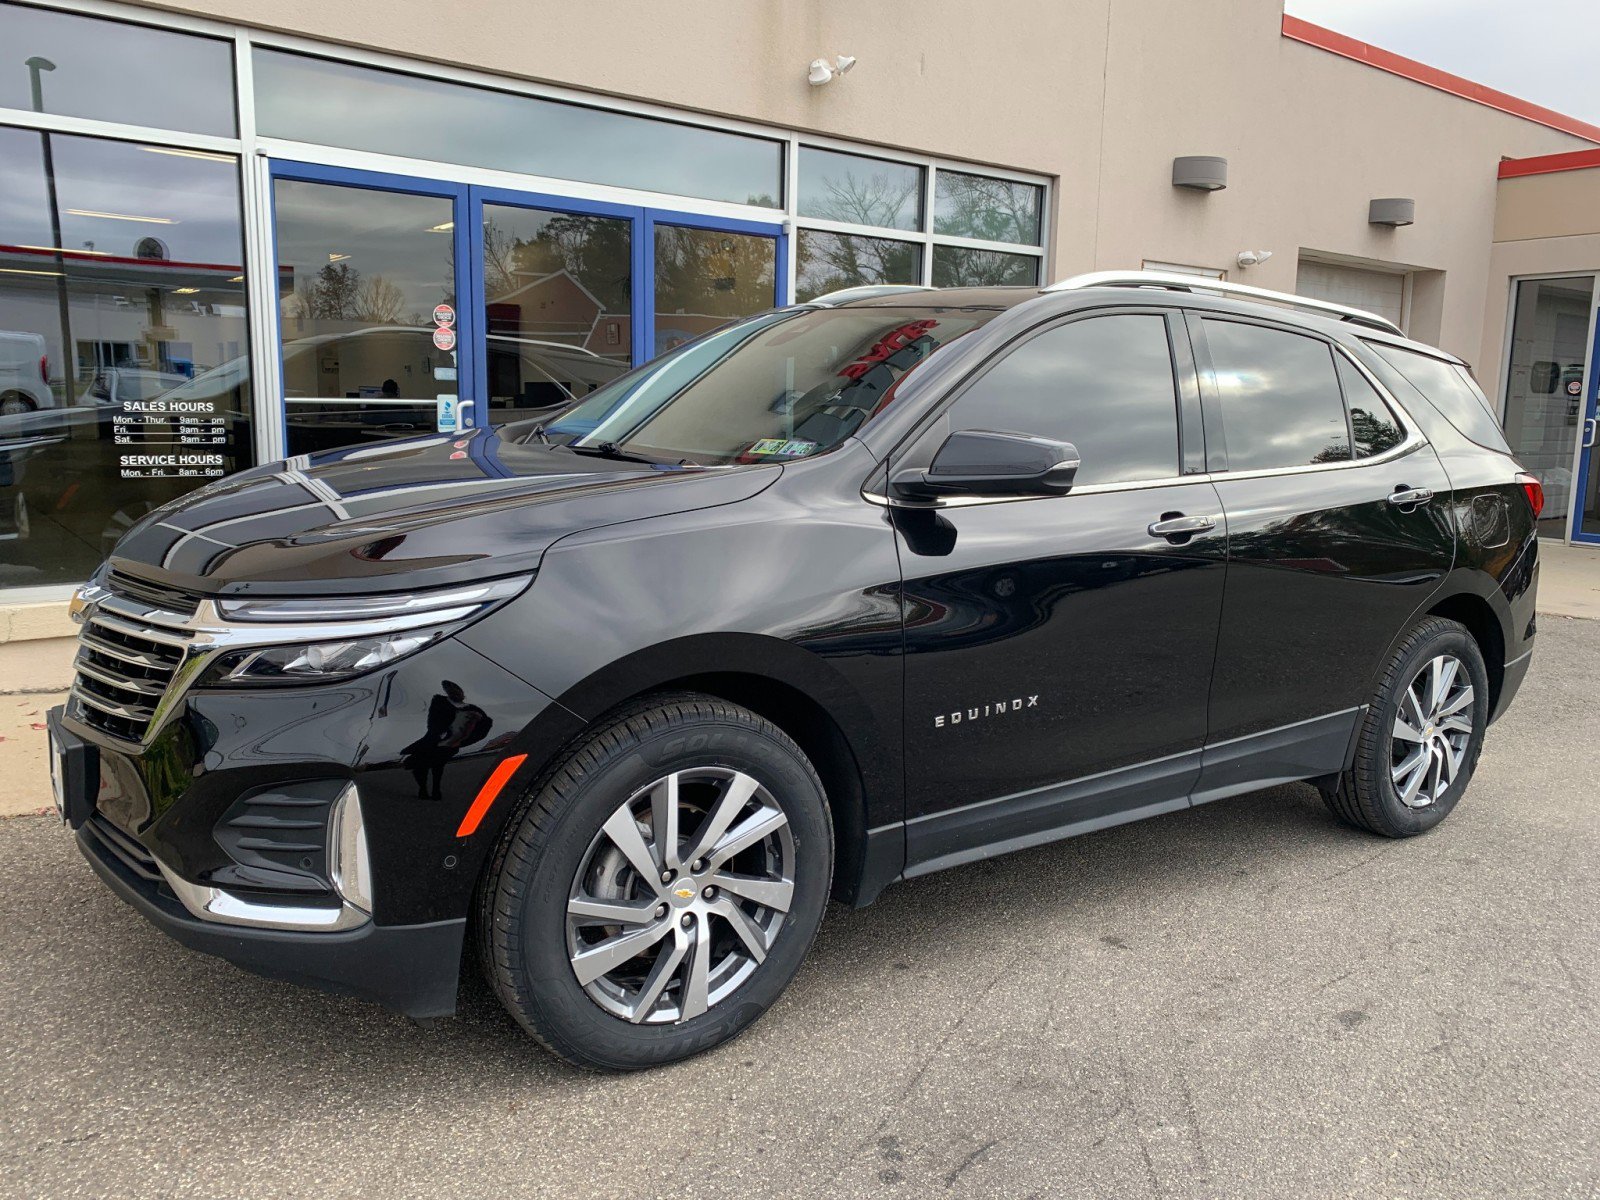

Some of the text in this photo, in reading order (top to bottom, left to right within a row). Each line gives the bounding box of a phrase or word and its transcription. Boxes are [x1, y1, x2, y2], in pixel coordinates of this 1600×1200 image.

[123, 401, 214, 412] SALES HOURS
[113, 416, 136, 424] Mon.
[144, 415, 167, 424] Thur.
[179, 416, 199, 424] 9am
[211, 417, 225, 425] pm
[114, 425, 129, 434] Fri.
[179, 426, 199, 434] 9am
[211, 427, 225, 435] pm
[114, 435, 133, 443] Sat.
[212, 437, 226, 445] pm
[120, 455, 223, 465] SERVICE HOURS
[120, 469, 143, 477] Mon.
[205, 468, 224, 476] 6pm
[934, 695, 1039, 728] EQUINOX
